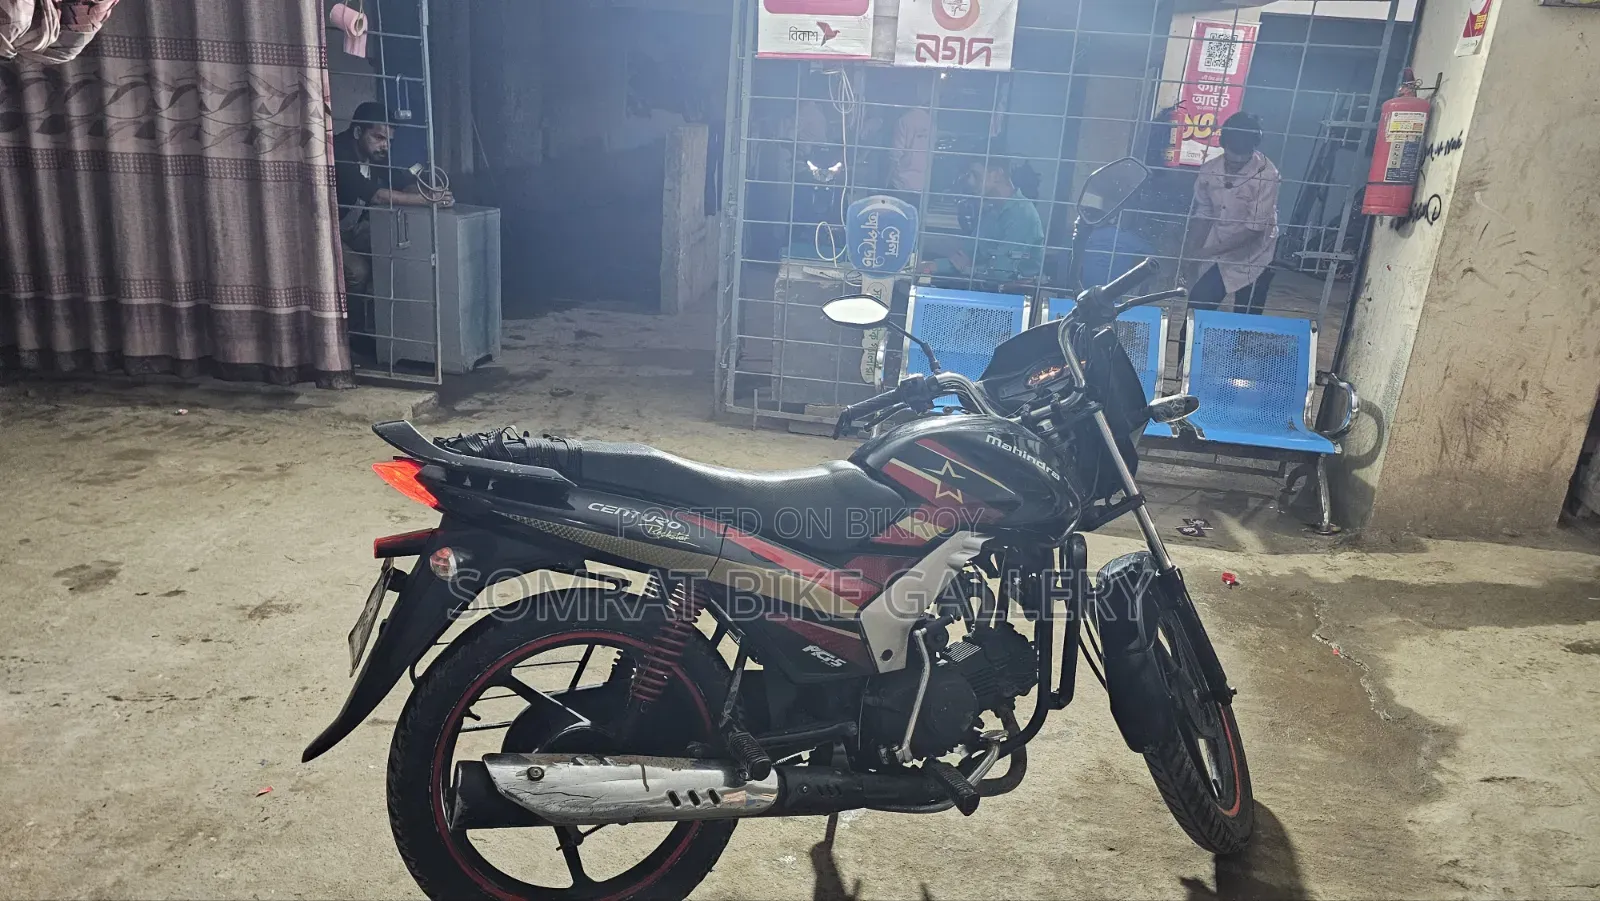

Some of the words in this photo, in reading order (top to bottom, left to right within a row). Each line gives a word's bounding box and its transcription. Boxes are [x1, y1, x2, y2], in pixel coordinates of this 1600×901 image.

[788, 26, 819, 42] বিকাশ
[915, 34, 994, 67] নগদ
[1192, 92, 1230, 107] আউট
[587, 502, 682, 529] CENTURO
